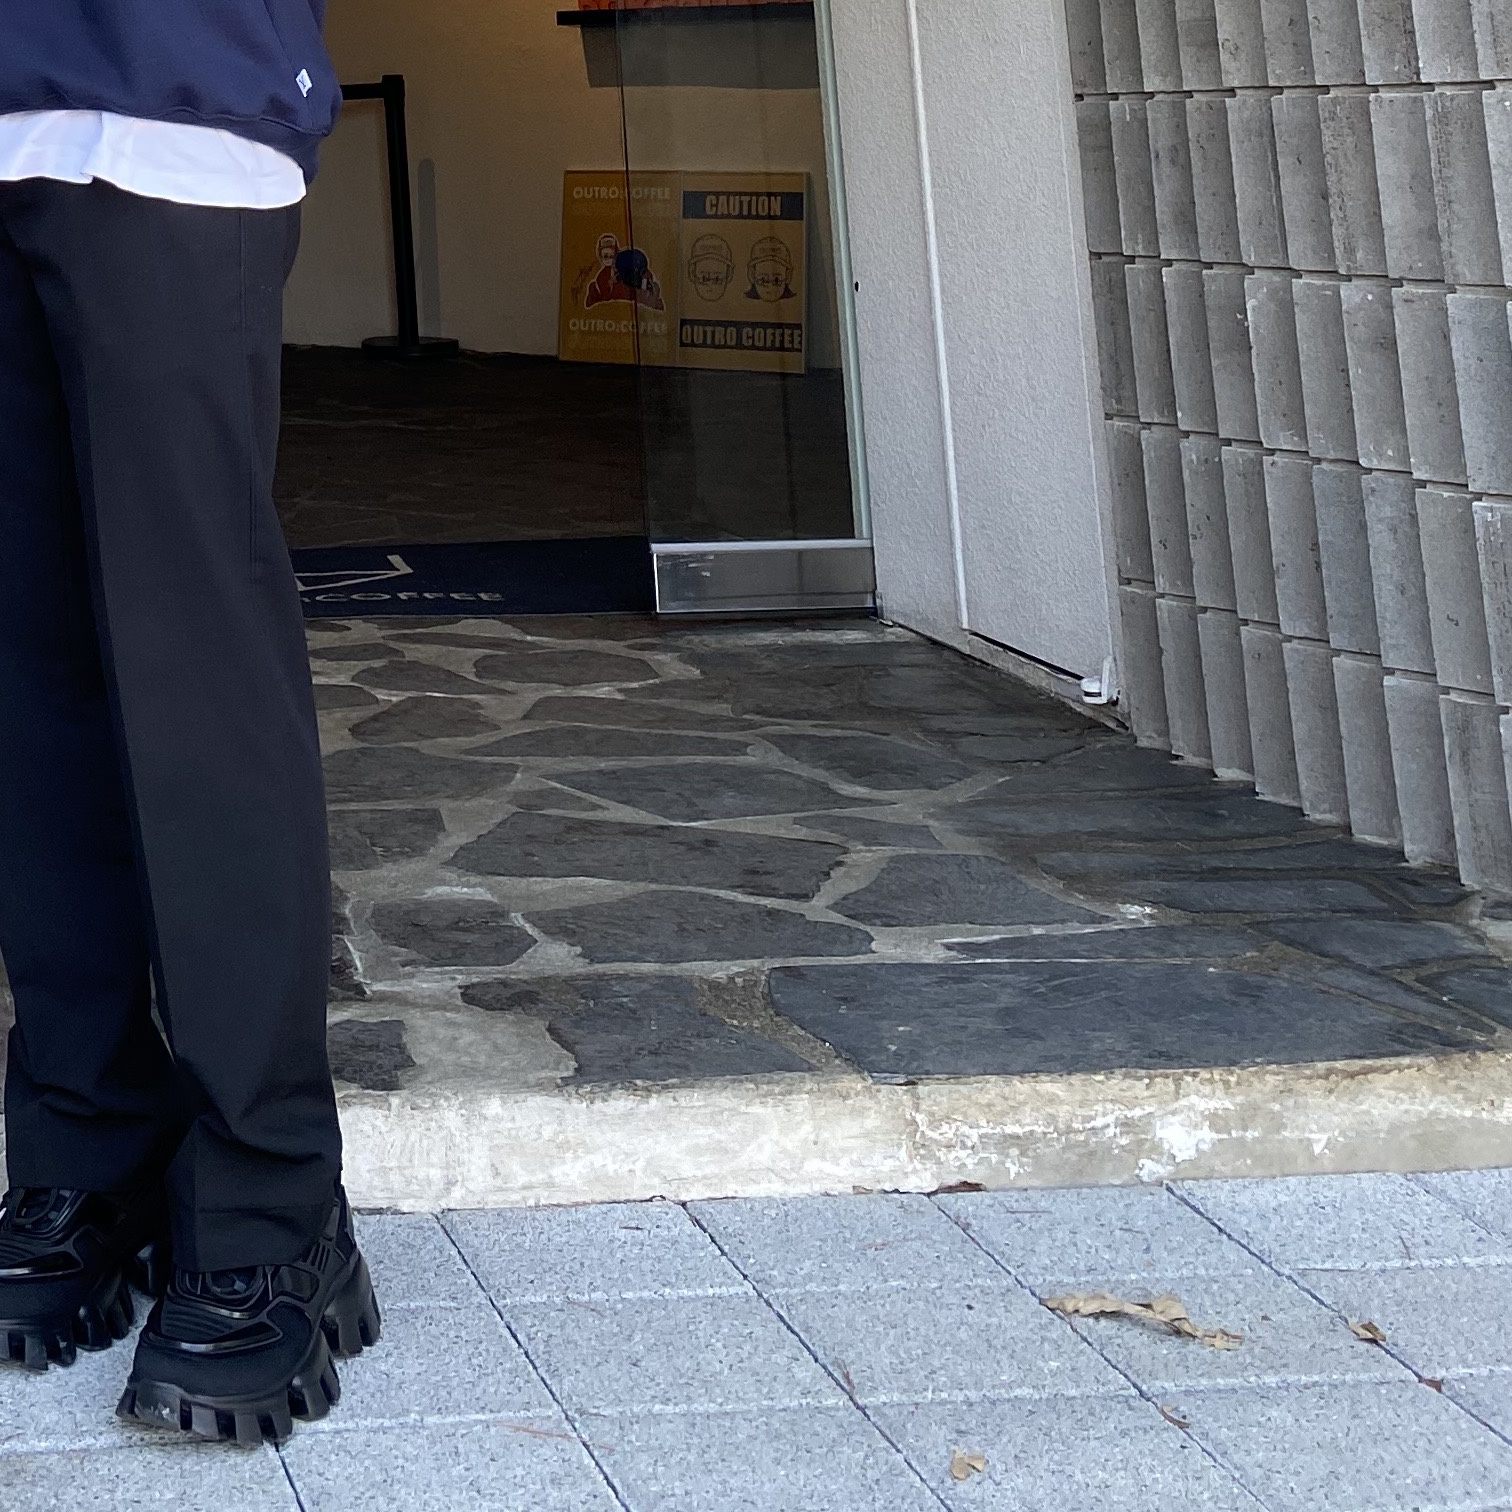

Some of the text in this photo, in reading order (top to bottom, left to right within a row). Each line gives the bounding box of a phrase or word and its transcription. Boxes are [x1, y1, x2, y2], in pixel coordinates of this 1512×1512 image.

[573, 186, 671, 200] OUTRO:OFFEE
[705, 195, 782, 217] CAUTION
[681, 325, 738, 346] OUTRO
[742, 327, 802, 350] COFFEE
